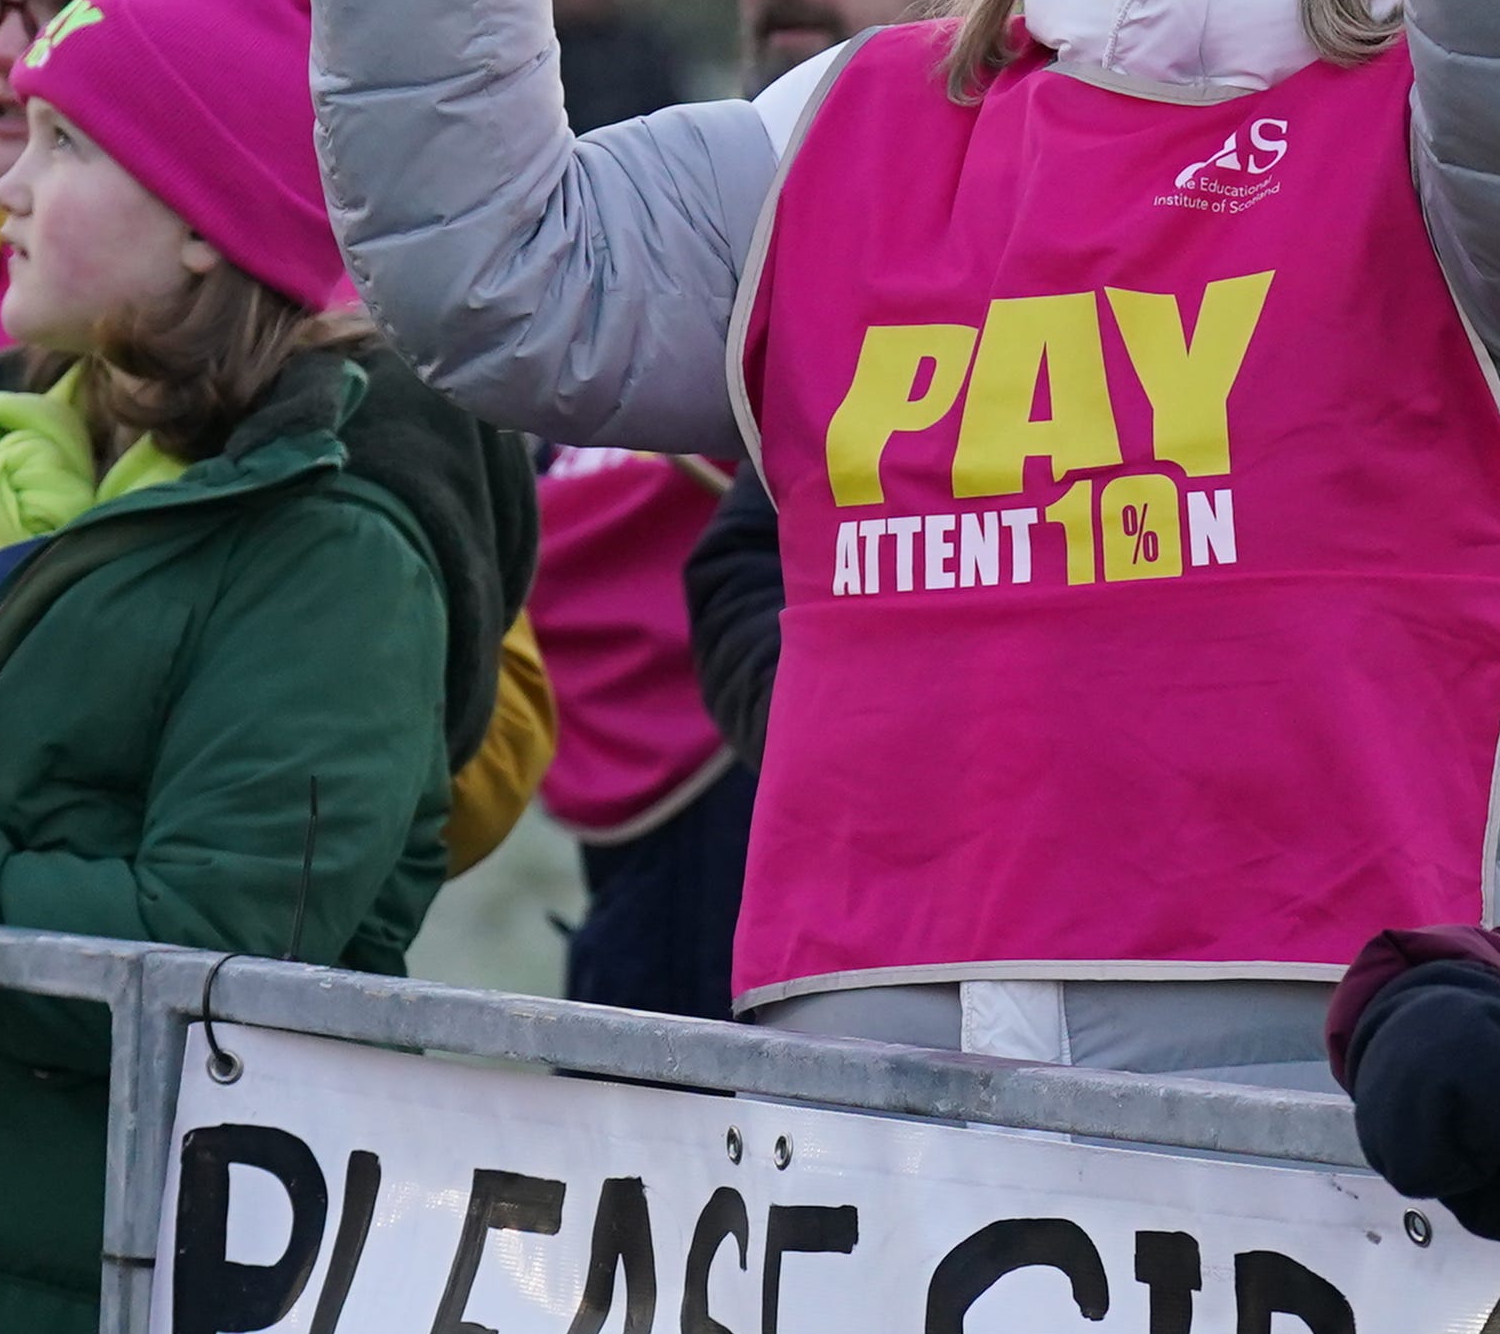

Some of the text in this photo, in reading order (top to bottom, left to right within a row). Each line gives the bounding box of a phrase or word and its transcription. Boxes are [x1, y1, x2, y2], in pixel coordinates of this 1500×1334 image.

[1153, 192, 1209, 211] Institute
[1211, 198, 1227, 213] of
[826, 269, 1276, 507] PAY
